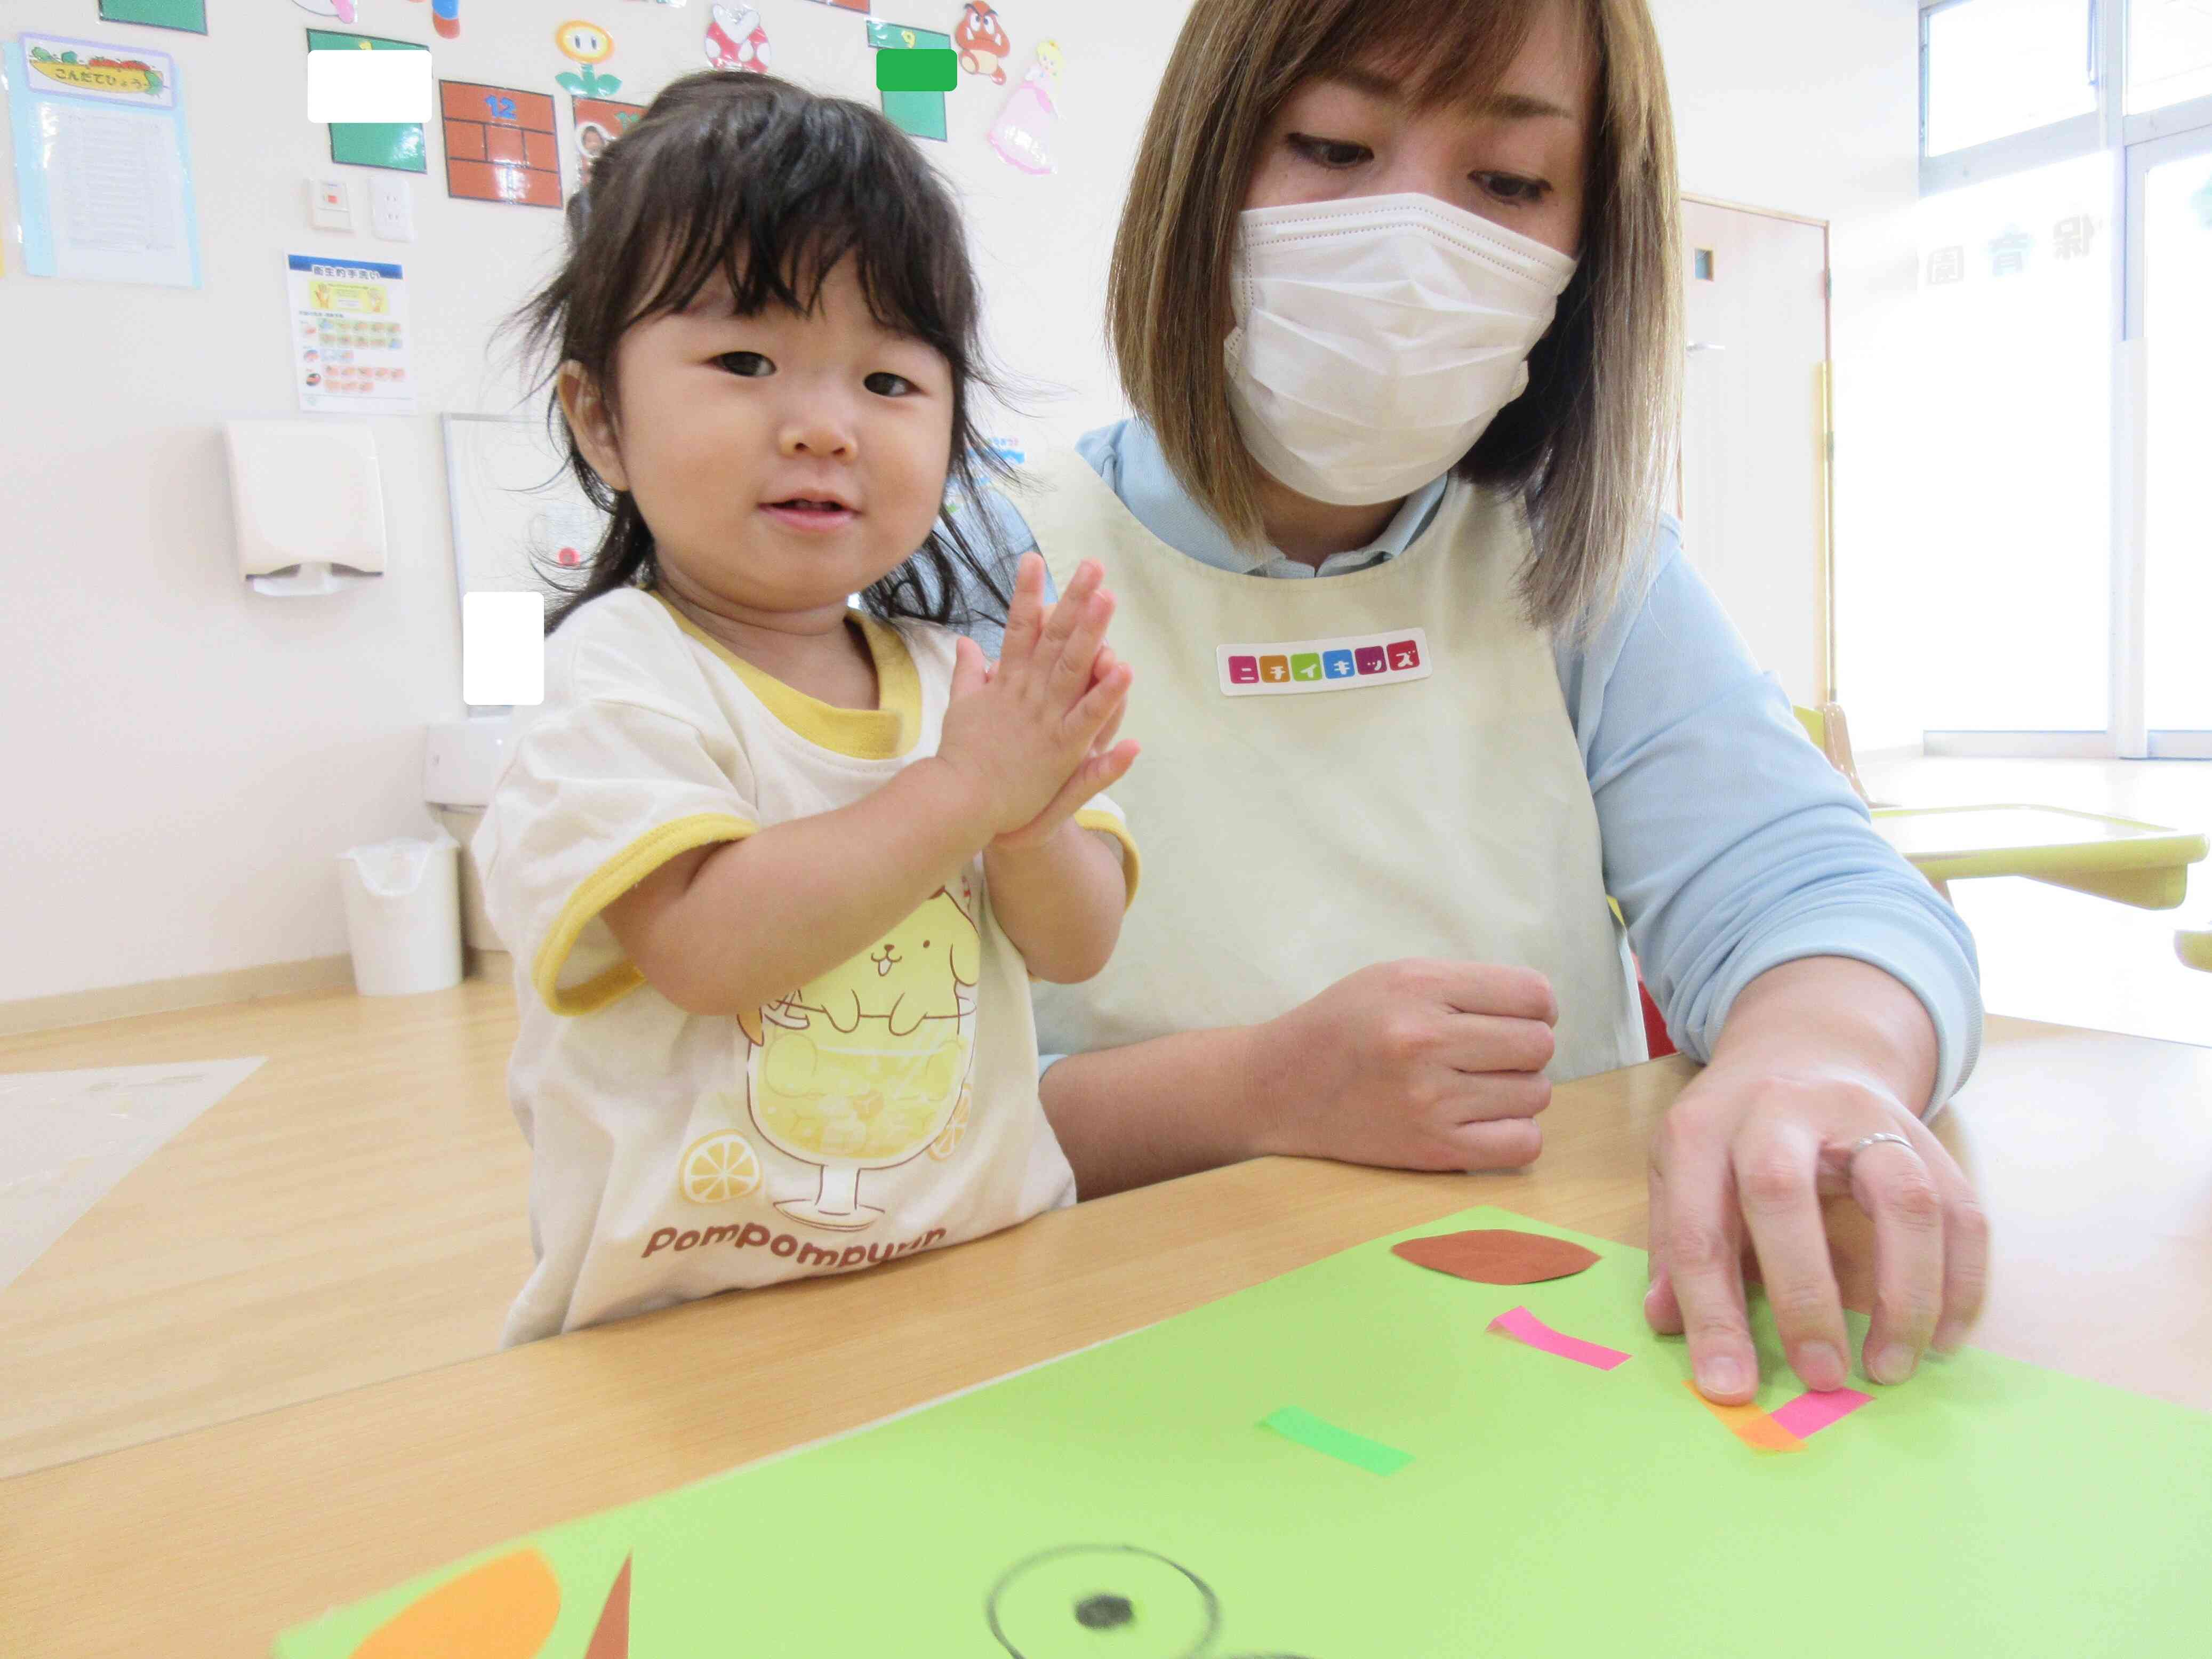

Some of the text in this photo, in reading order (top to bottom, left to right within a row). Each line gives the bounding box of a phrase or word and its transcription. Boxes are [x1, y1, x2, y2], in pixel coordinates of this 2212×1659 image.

[901, 30, 916, 49] 9
[486, 95, 517, 119] 12
[1239, 648, 1416, 681] ニチイキッズ
